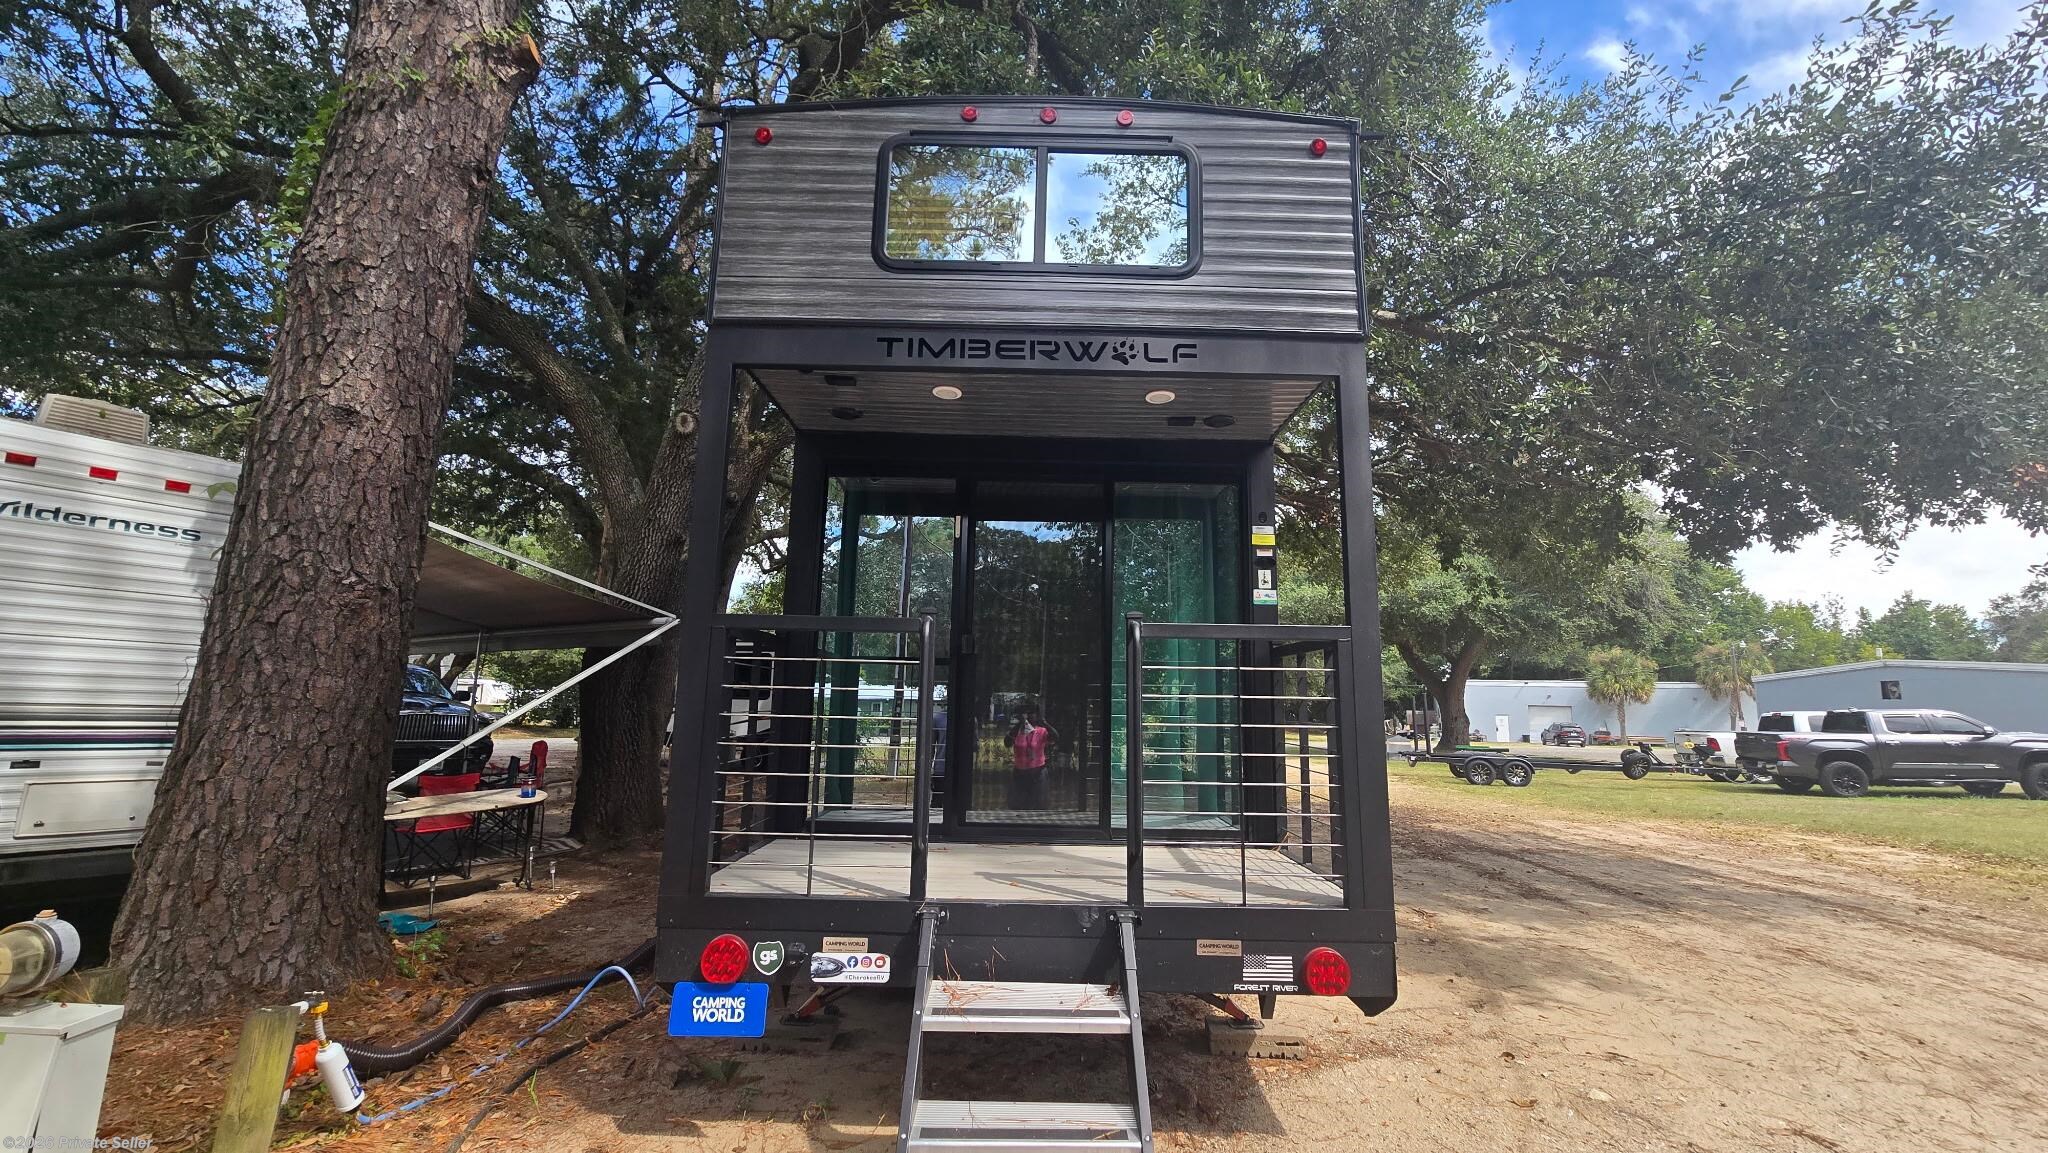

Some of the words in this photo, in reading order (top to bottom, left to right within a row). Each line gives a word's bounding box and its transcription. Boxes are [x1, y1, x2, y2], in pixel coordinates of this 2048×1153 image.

[759, 949, 778, 965] gs
[1233, 983, 1270, 992] FOREST
[1272, 984, 1299, 992] RIVER
[692, 996, 746, 1010] CAMPING
[692, 1008, 745, 1023] WORLD
